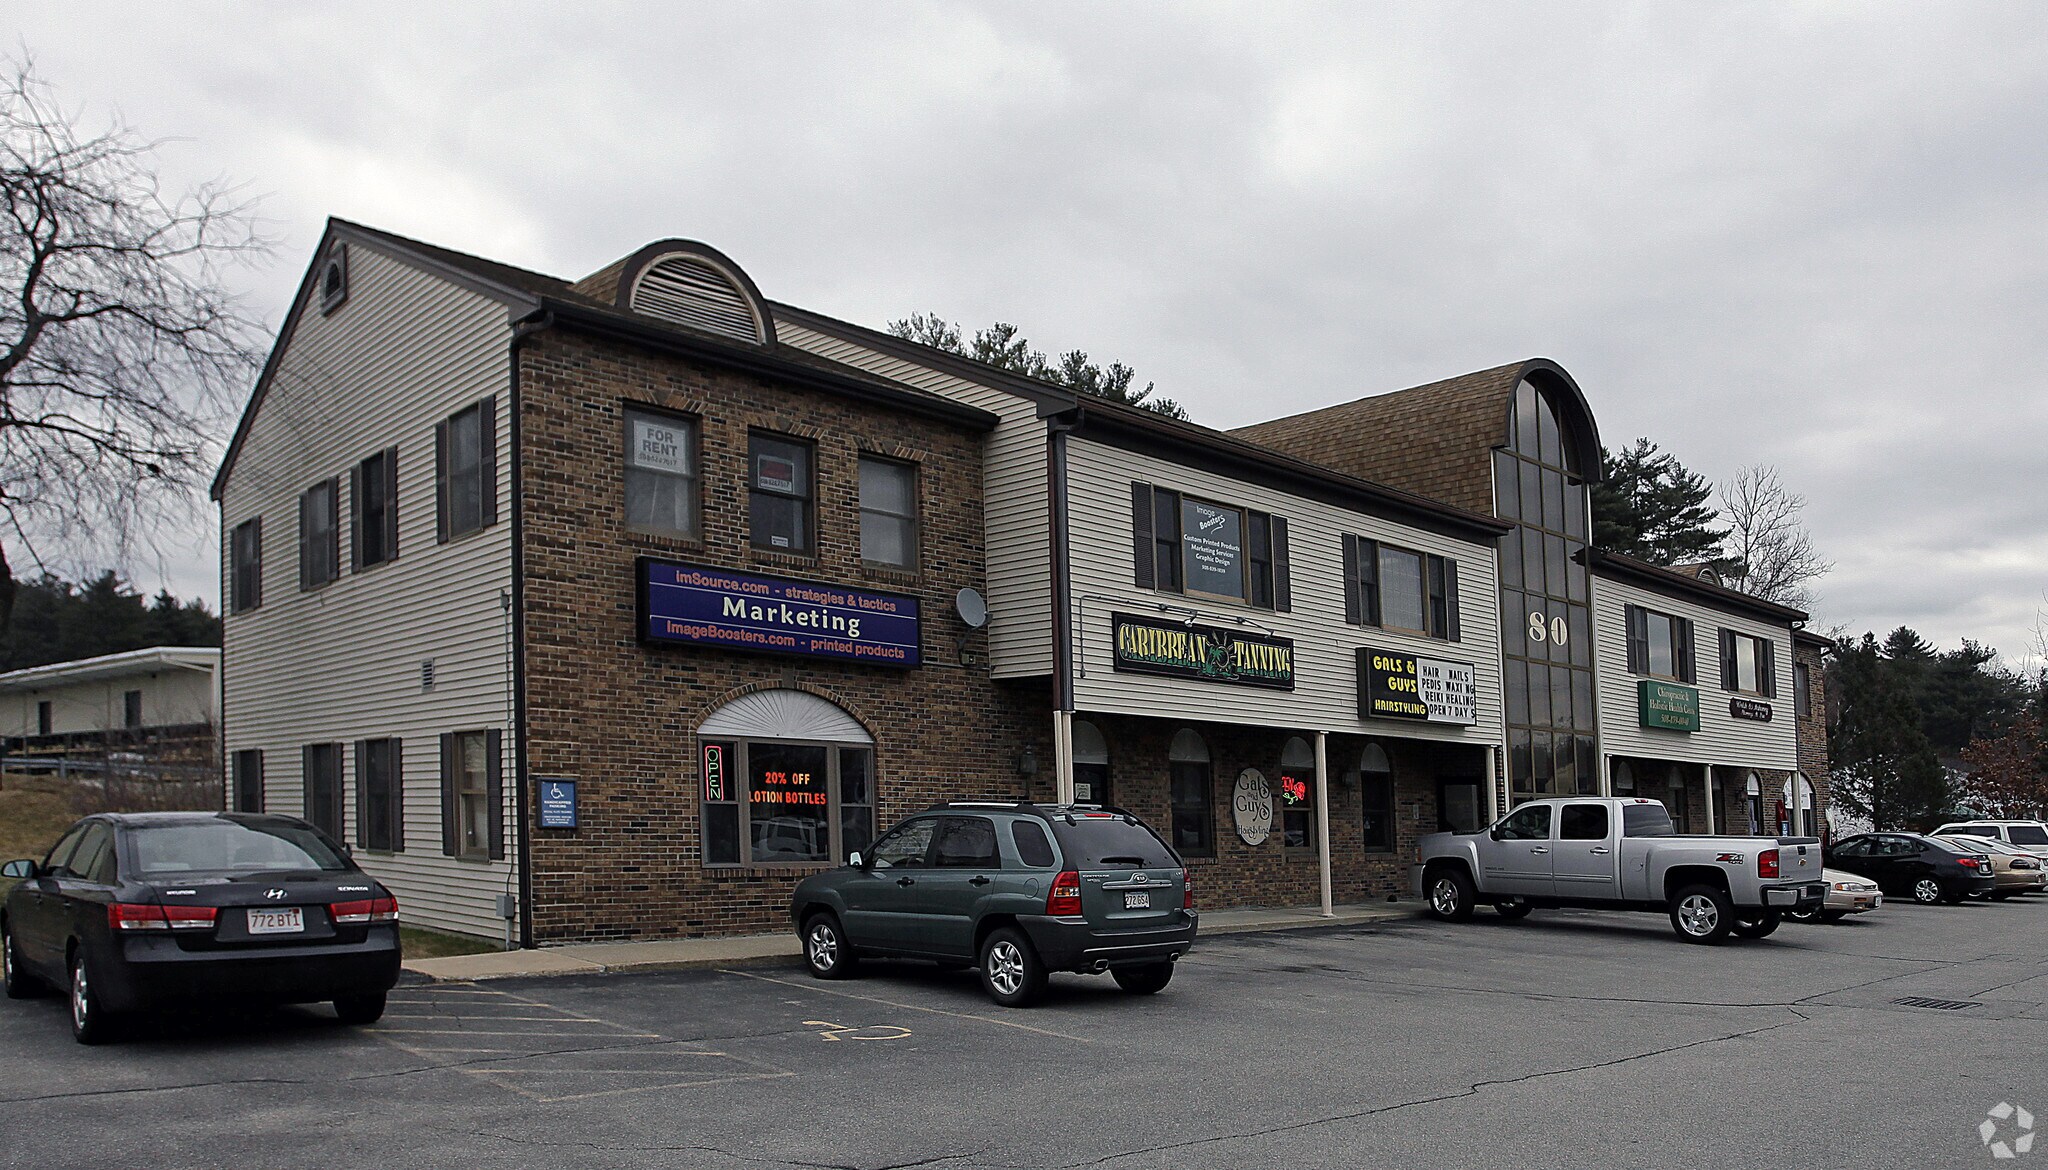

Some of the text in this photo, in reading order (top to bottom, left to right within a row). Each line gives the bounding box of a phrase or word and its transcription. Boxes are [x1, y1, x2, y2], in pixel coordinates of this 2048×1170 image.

[647, 428, 673, 443] FOR
[642, 440, 678, 457] RENT
[1196, 505, 1216, 518] Image
[1183, 533, 1240, 552] Custom Printed Products
[1191, 543, 1234, 559] Marketing Services
[1195, 553, 1231, 567] Graphic Design
[785, 586, 844, 606] strategies
[847, 594, 857, 607] &
[858, 596, 897, 612] tactics
[722, 596, 861, 638] Marketing
[1528, 611, 1568, 646] 80
[666, 619, 795, 647] ImageBoosters.com
[810, 638, 853, 653] printed
[855, 644, 906, 660] products
[1118, 622, 1292, 681] CARIBBEAN TANNING
[1373, 655, 1416, 674] GALS &
[1422, 665, 1469, 682] HAIR NAILS
[1387, 676, 1417, 693] GUYS
[1421, 678, 1442, 691] PEDIS
[1374, 699, 1427, 715] HAIRSTYLING
[1425, 690, 1474, 707] REIKI HEALING
[1429, 704, 1446, 715] OPEN
[1448, 706, 1453, 715] 7
[706, 749, 722, 800] OPEN
[765, 772, 810, 785] 20% OFF
[1238, 773, 1271, 800] Gals
[748, 791, 827, 806] LOTION BOTTLES
[1236, 795, 1271, 822] Guys
[251, 913, 300, 928] 772 BT1
